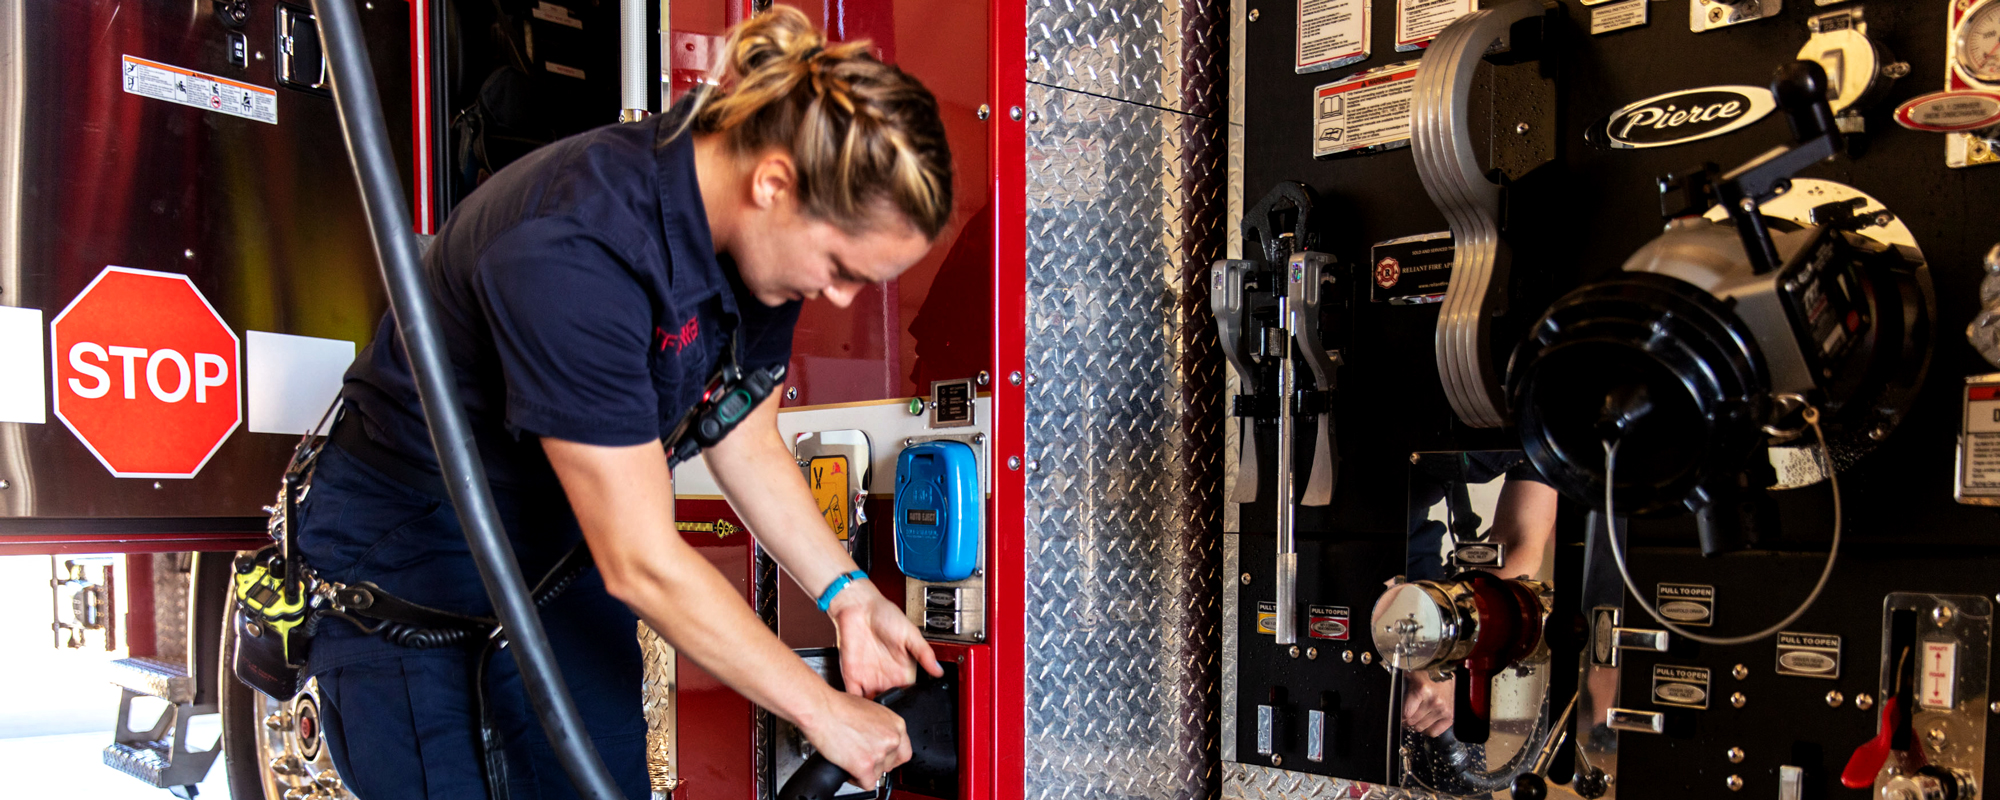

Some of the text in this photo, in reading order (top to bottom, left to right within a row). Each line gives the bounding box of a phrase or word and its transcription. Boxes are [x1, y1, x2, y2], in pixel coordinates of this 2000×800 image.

[1368, 75, 1393, 86] WARNING
[1617, 100, 1741, 138] Pierce
[1402, 265, 1427, 273] RELIANT
[68, 342, 229, 403] STOP
[922, 513, 935, 521] EJECT
